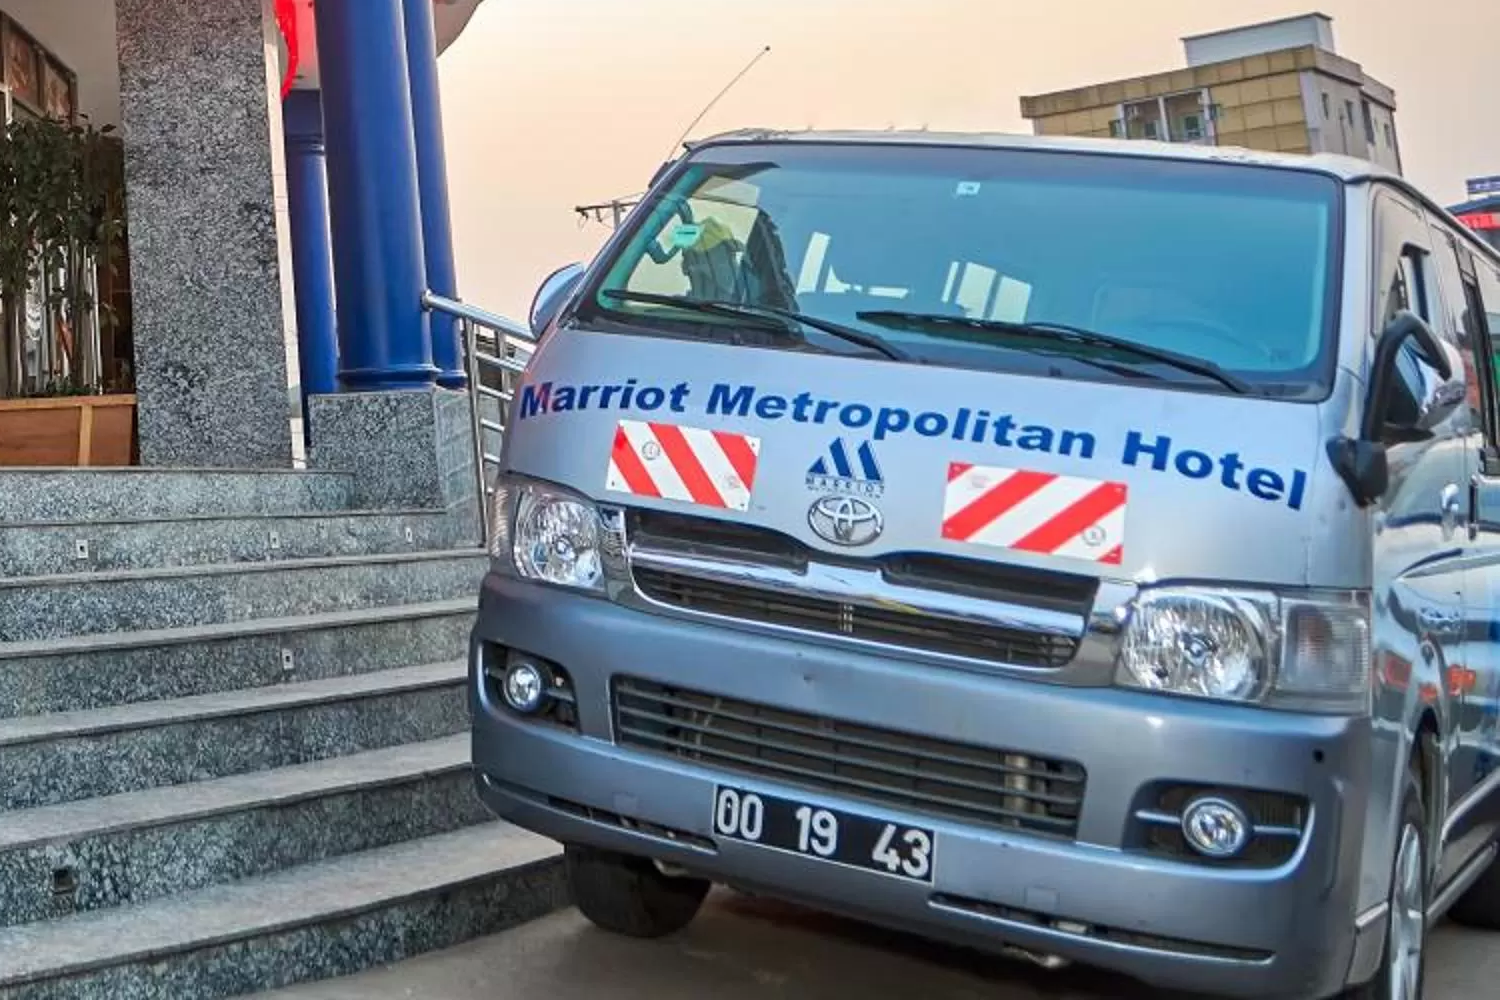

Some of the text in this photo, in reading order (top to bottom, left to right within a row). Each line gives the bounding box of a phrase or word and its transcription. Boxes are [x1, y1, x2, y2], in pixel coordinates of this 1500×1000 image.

[518, 378, 1308, 512] Marriot Metropolitan Hotel
[716, 788, 932, 878] 00 19 43
